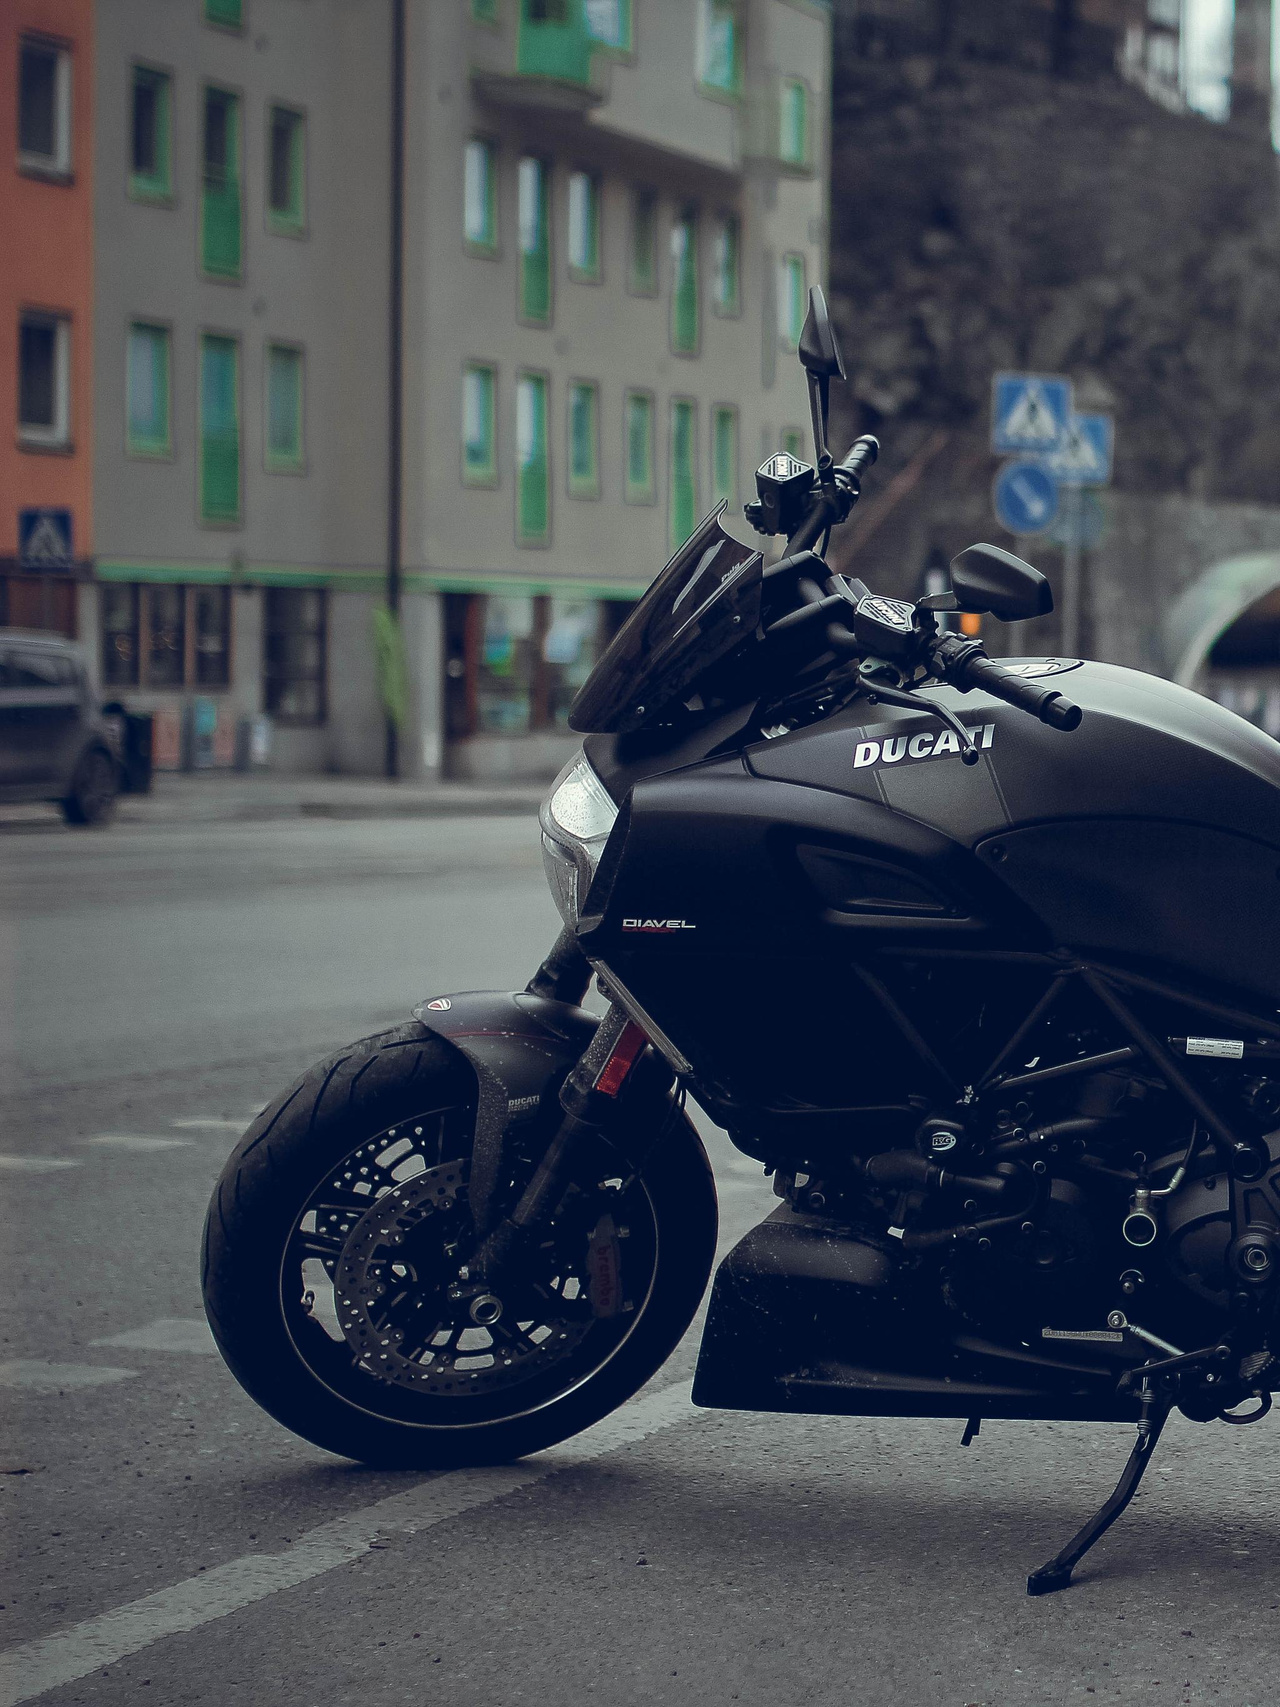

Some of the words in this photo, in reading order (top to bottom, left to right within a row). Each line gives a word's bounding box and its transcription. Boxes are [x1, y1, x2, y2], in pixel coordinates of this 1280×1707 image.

[853, 723, 996, 769] DUCATI
[622, 918, 697, 929] DIAVEL
[508, 1095, 540, 1107] DUCATI
[597, 1244, 614, 1306] brembo
